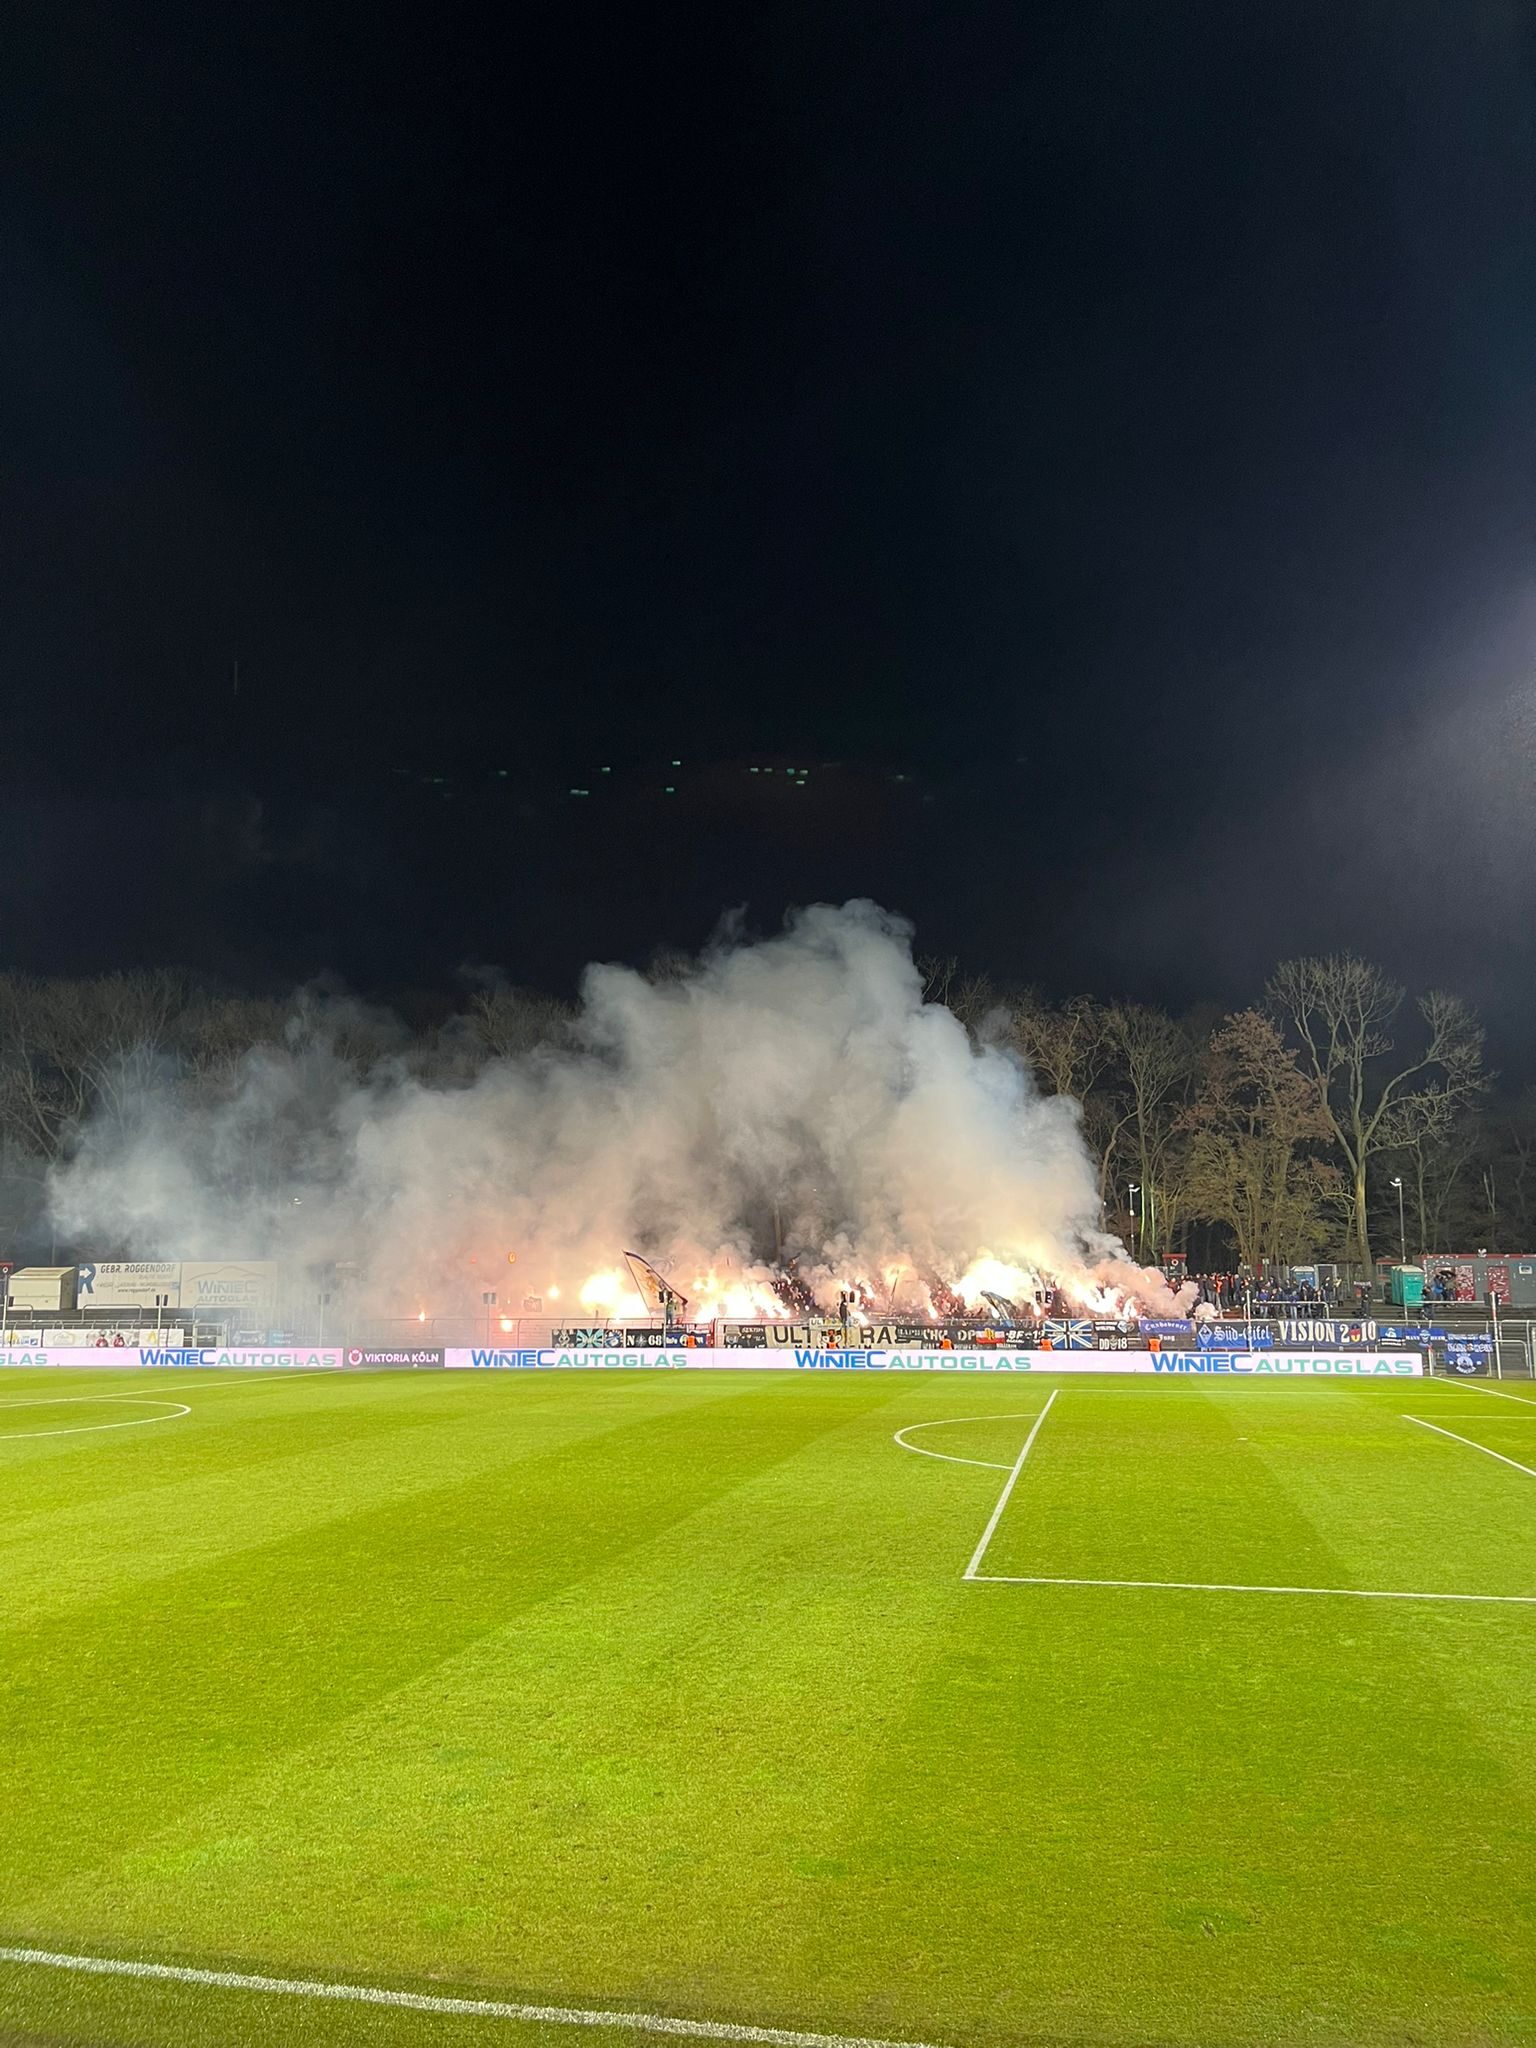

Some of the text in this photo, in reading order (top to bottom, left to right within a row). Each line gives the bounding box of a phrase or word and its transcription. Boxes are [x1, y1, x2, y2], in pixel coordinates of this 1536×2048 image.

[100, 1264, 176, 1274] GEBR. ROGGENDORF
[1214, 1325, 1270, 1342] Süd-Eifel
[1278, 1320, 1336, 1343] VISION
[626, 1336, 635, 1346] N
[648, 1335, 662, 1346] 68
[1099, 1337, 1128, 1350] DD 18
[217, 1353, 336, 1366] AUTOGLAS
[364, 1351, 439, 1363] VIKTORIA KÖLN
[557, 1354, 687, 1368] AUTOGLAS
[888, 1356, 1032, 1370] AUTOGLAS
[1256, 1359, 1414, 1374] AUTOGLAS
